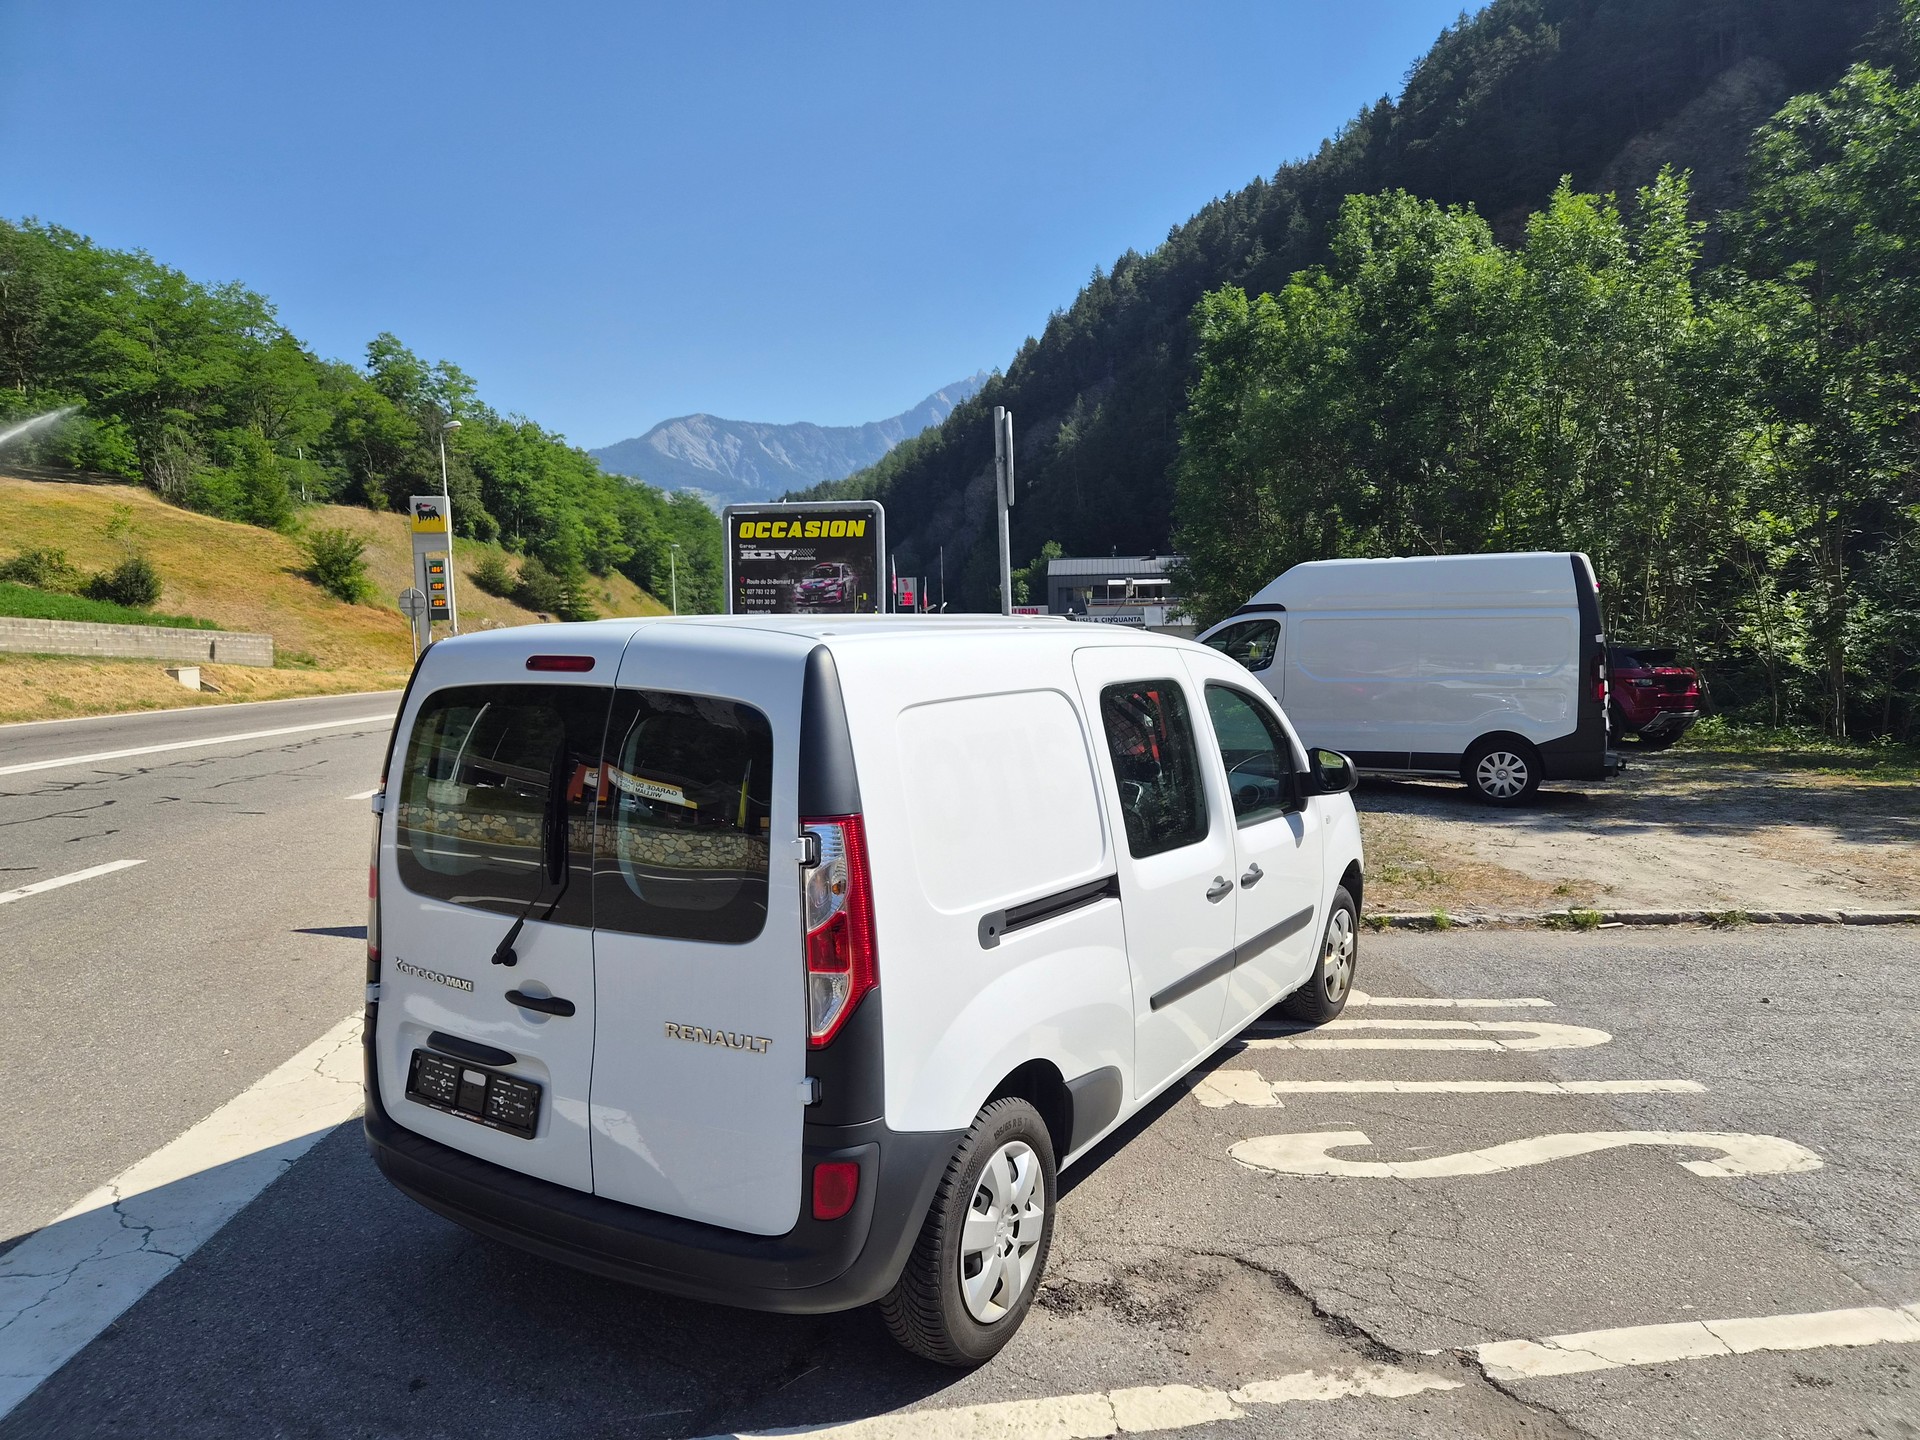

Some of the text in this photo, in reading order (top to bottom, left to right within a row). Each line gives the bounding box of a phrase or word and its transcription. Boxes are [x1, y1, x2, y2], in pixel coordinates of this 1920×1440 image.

[739, 520, 866, 539] OCCASION
[1100, 616, 1142, 624] CINQUANTA
[664, 1021, 773, 1054] RENAULT
